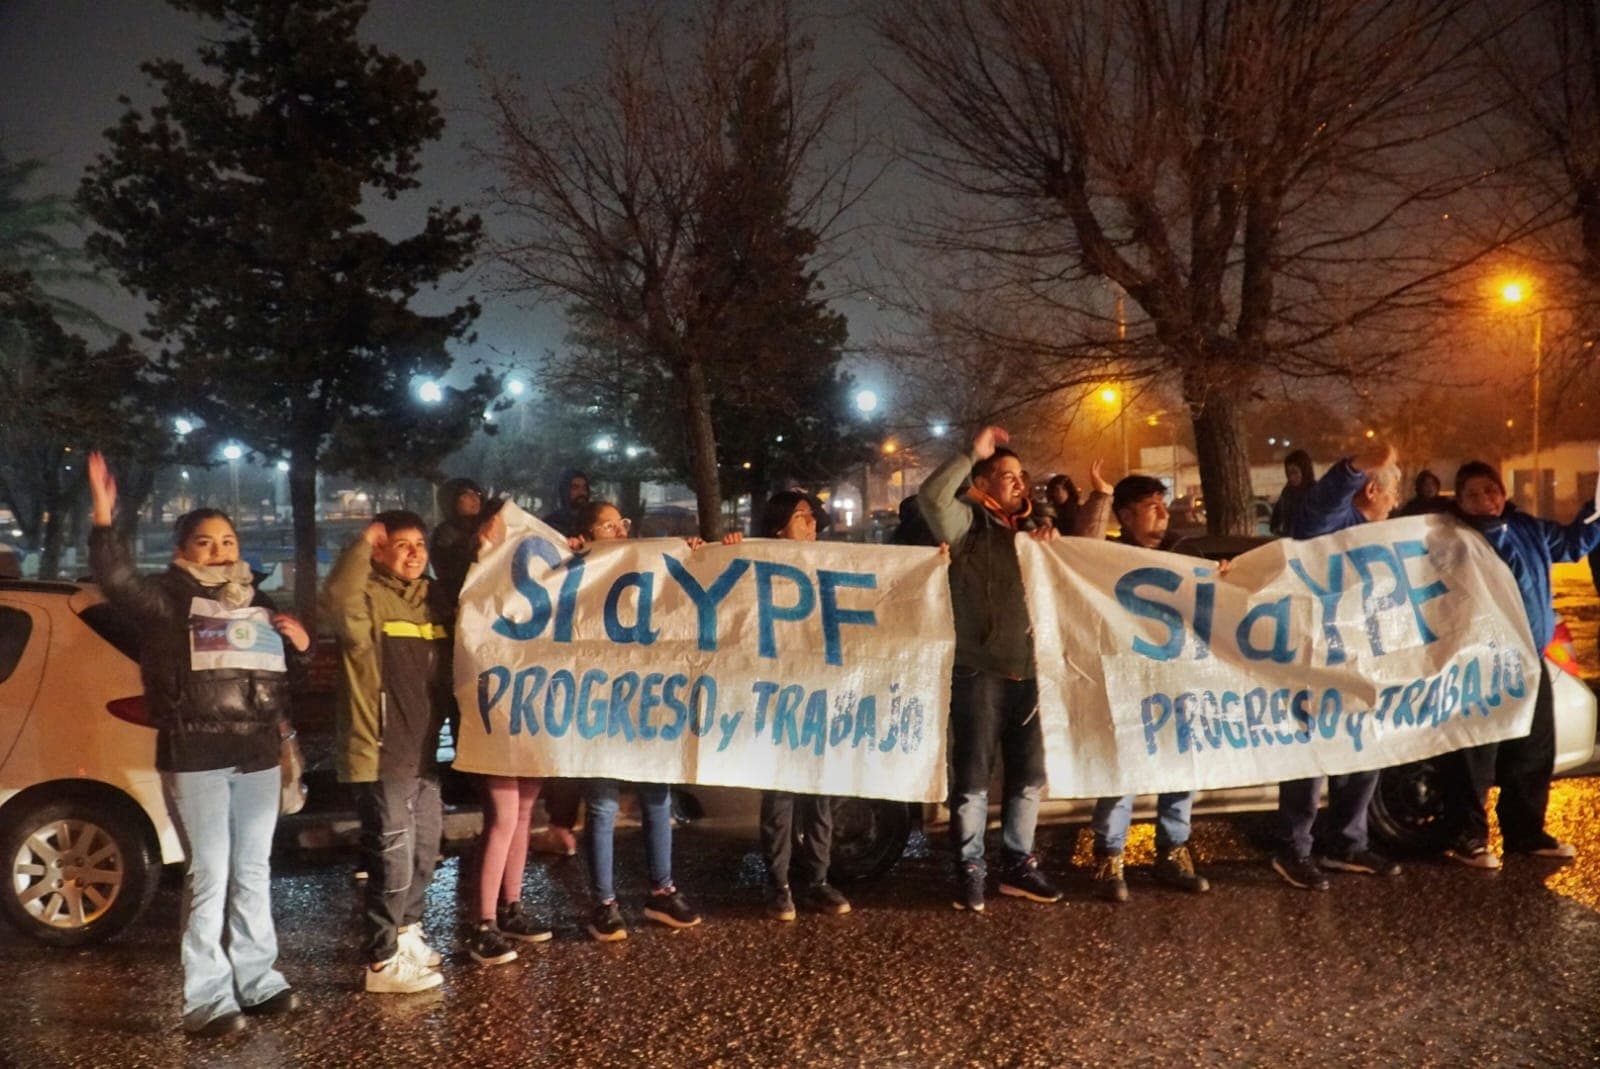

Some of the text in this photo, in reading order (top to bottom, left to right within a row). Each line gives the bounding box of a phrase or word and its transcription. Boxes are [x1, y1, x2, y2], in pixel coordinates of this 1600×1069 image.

[603, 568, 661, 645] a
[662, 552, 877, 667] YPF
[1236, 596, 1299, 665] a
[1289, 539, 1449, 668] YPF
[478, 665, 717, 742] PROGRESO
[719, 711, 743, 753] y
[1141, 685, 1339, 757] PROGRESO
